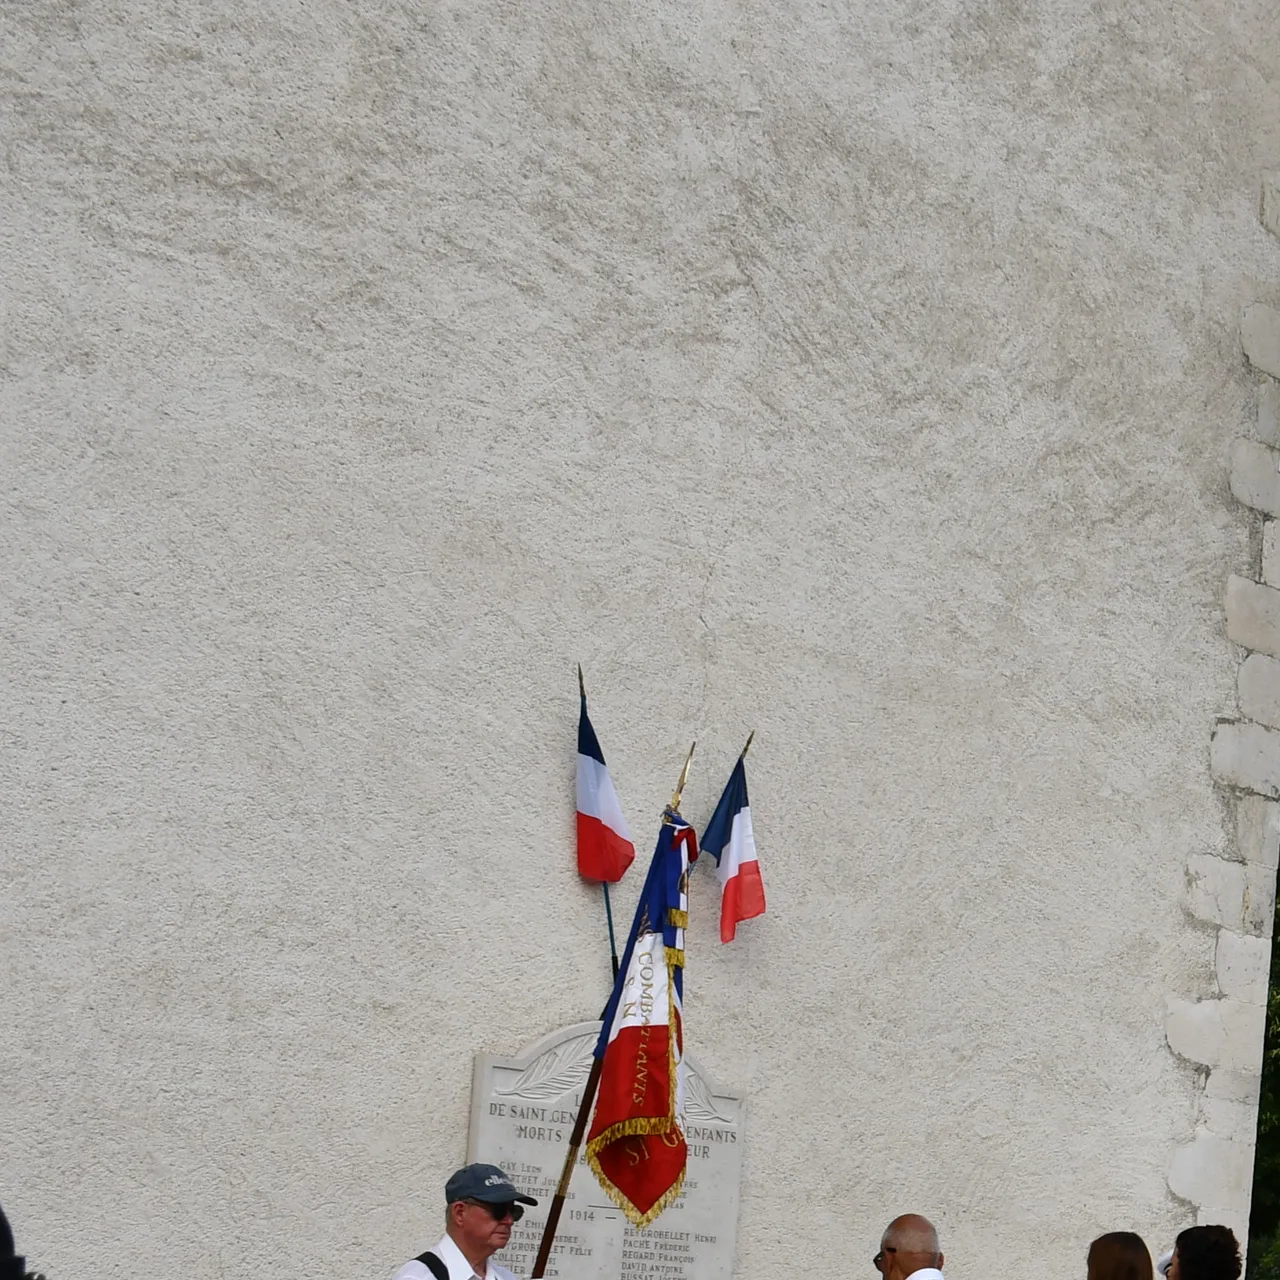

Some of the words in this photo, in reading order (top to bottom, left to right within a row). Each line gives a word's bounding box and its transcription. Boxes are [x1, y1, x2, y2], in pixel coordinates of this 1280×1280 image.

[489, 1103, 507, 1117] DE
[510, 1105, 548, 1121] SAINT
[552, 1110, 579, 1124] GEN
[686, 1126, 737, 1144] ENFANTS
[516, 1126, 563, 1143] MORTS
[499, 1161, 517, 1172] GAY
[570, 1210, 595, 1222] 1914
[525, 1220, 547, 1232] EMIL
[622, 1250, 655, 1261] REGARD
[621, 1261, 648, 1273] DAVID
